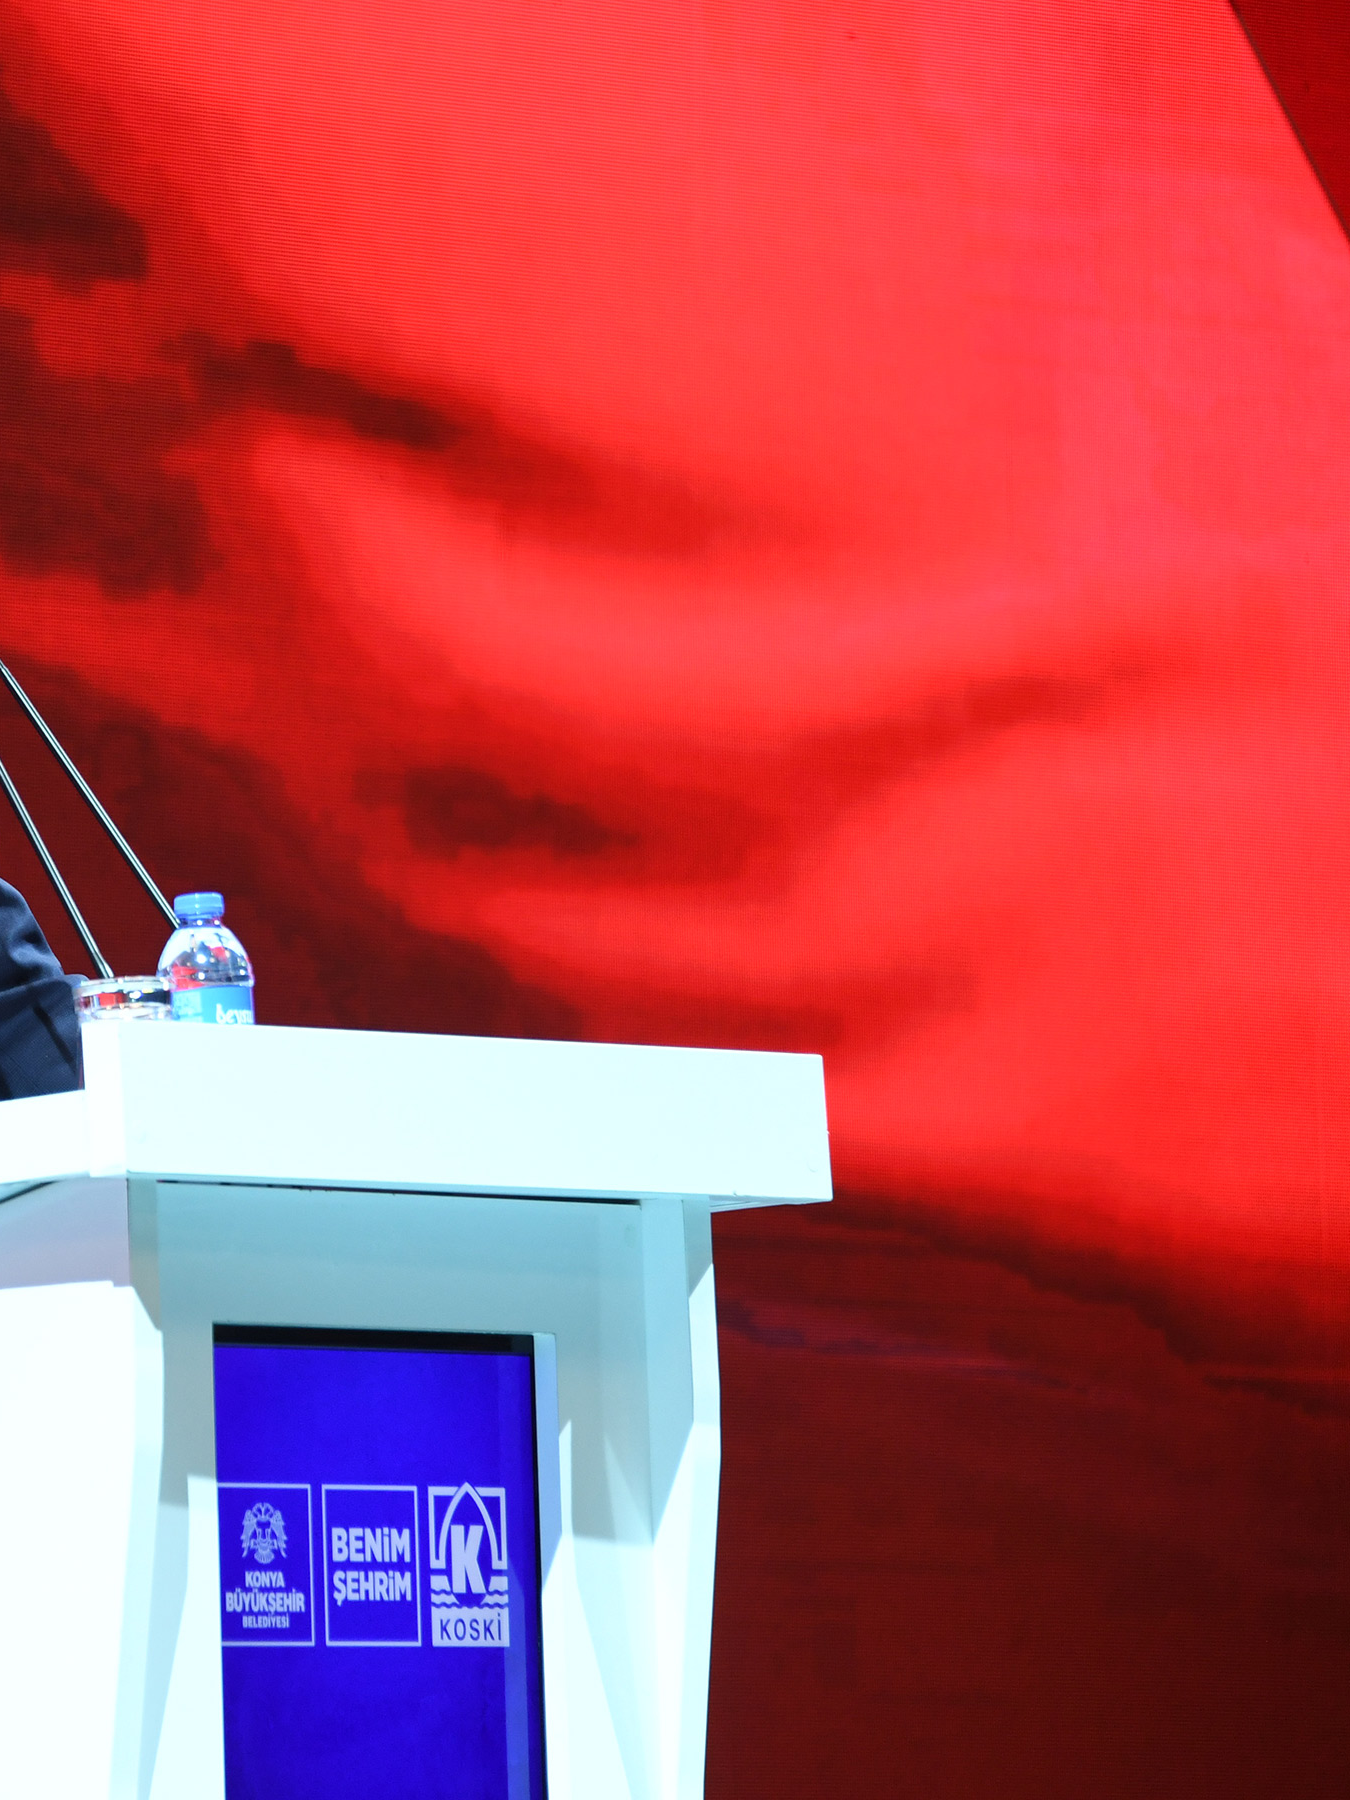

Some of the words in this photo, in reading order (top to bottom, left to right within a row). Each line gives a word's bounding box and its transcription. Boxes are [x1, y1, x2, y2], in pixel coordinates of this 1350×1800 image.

[450, 1525, 487, 1593] K
[245, 1571, 285, 1588] KONYA
[226, 1587, 305, 1614] BÜYÜKŞEHİR
[242, 1613, 290, 1628] BELEDİYESİ
[440, 1612, 502, 1641] KOSKİ
